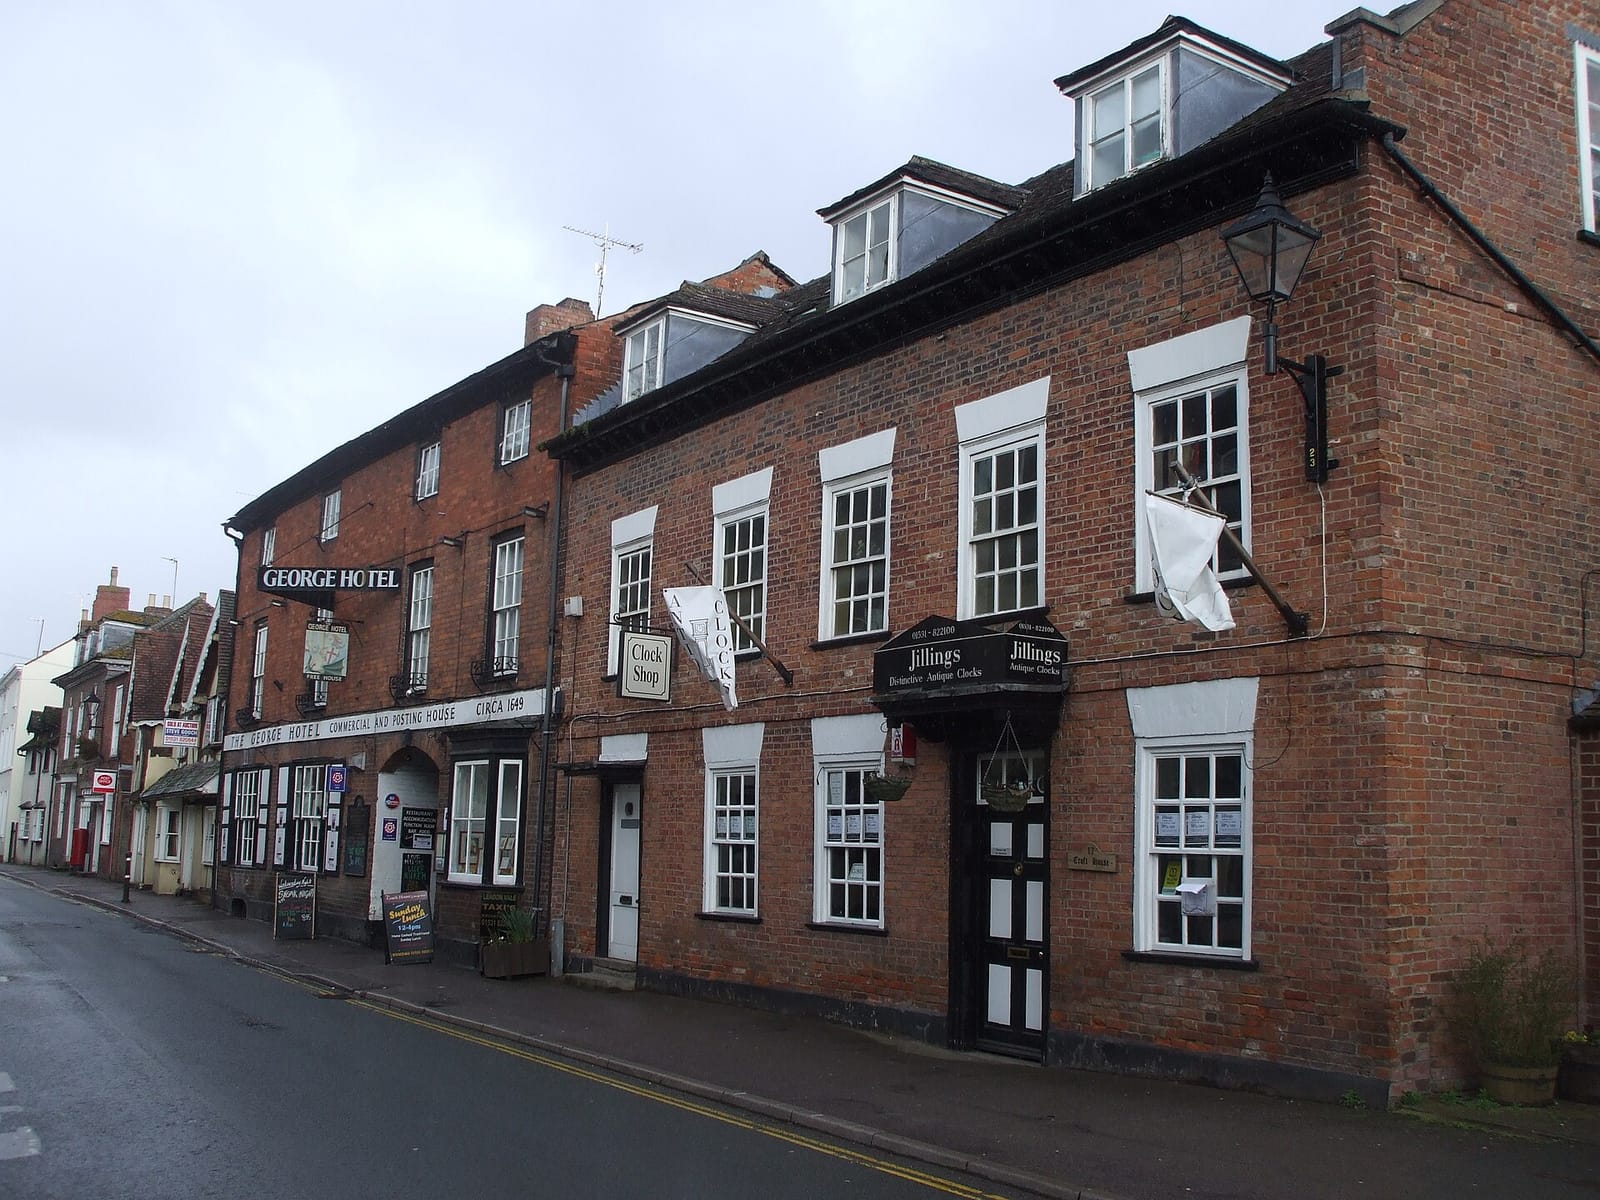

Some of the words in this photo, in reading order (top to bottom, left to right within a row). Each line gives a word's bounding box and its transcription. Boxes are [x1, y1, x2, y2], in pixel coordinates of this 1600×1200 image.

[1309, 447, 1316, 467] 23
[263, 569, 336, 588] GEORGE
[340, 569, 399, 588] HOTEL
[307, 623, 329, 631] GEORGE
[330, 625, 347, 633] HOTEL
[632, 643, 663, 663] Clock
[908, 647, 961, 672] Jillings
[1010, 640, 1061, 666] Jillings
[633, 664, 659, 688] Shop
[889, 673, 923, 687] Distinctive
[926, 671, 954, 684] Antique
[957, 666, 982, 679] Clocks
[1009, 662, 1035, 674] Antique
[1036, 665, 1060, 676] Clocks
[231, 734, 245, 749] THE
[250, 728, 282, 745] GEORGE
[289, 723, 321, 741] HOTEL
[329, 718, 371, 734] COMMERCIAL
[375, 716, 389, 729] AND
[392, 711, 423, 727] POSTING
[426, 707, 456, 723] HOUSE
[476, 700, 504, 716] CIRCA
[507, 696, 525, 712] 1649
[389, 904, 421, 920] Sunday
[402, 908, 426, 924] Lunch
